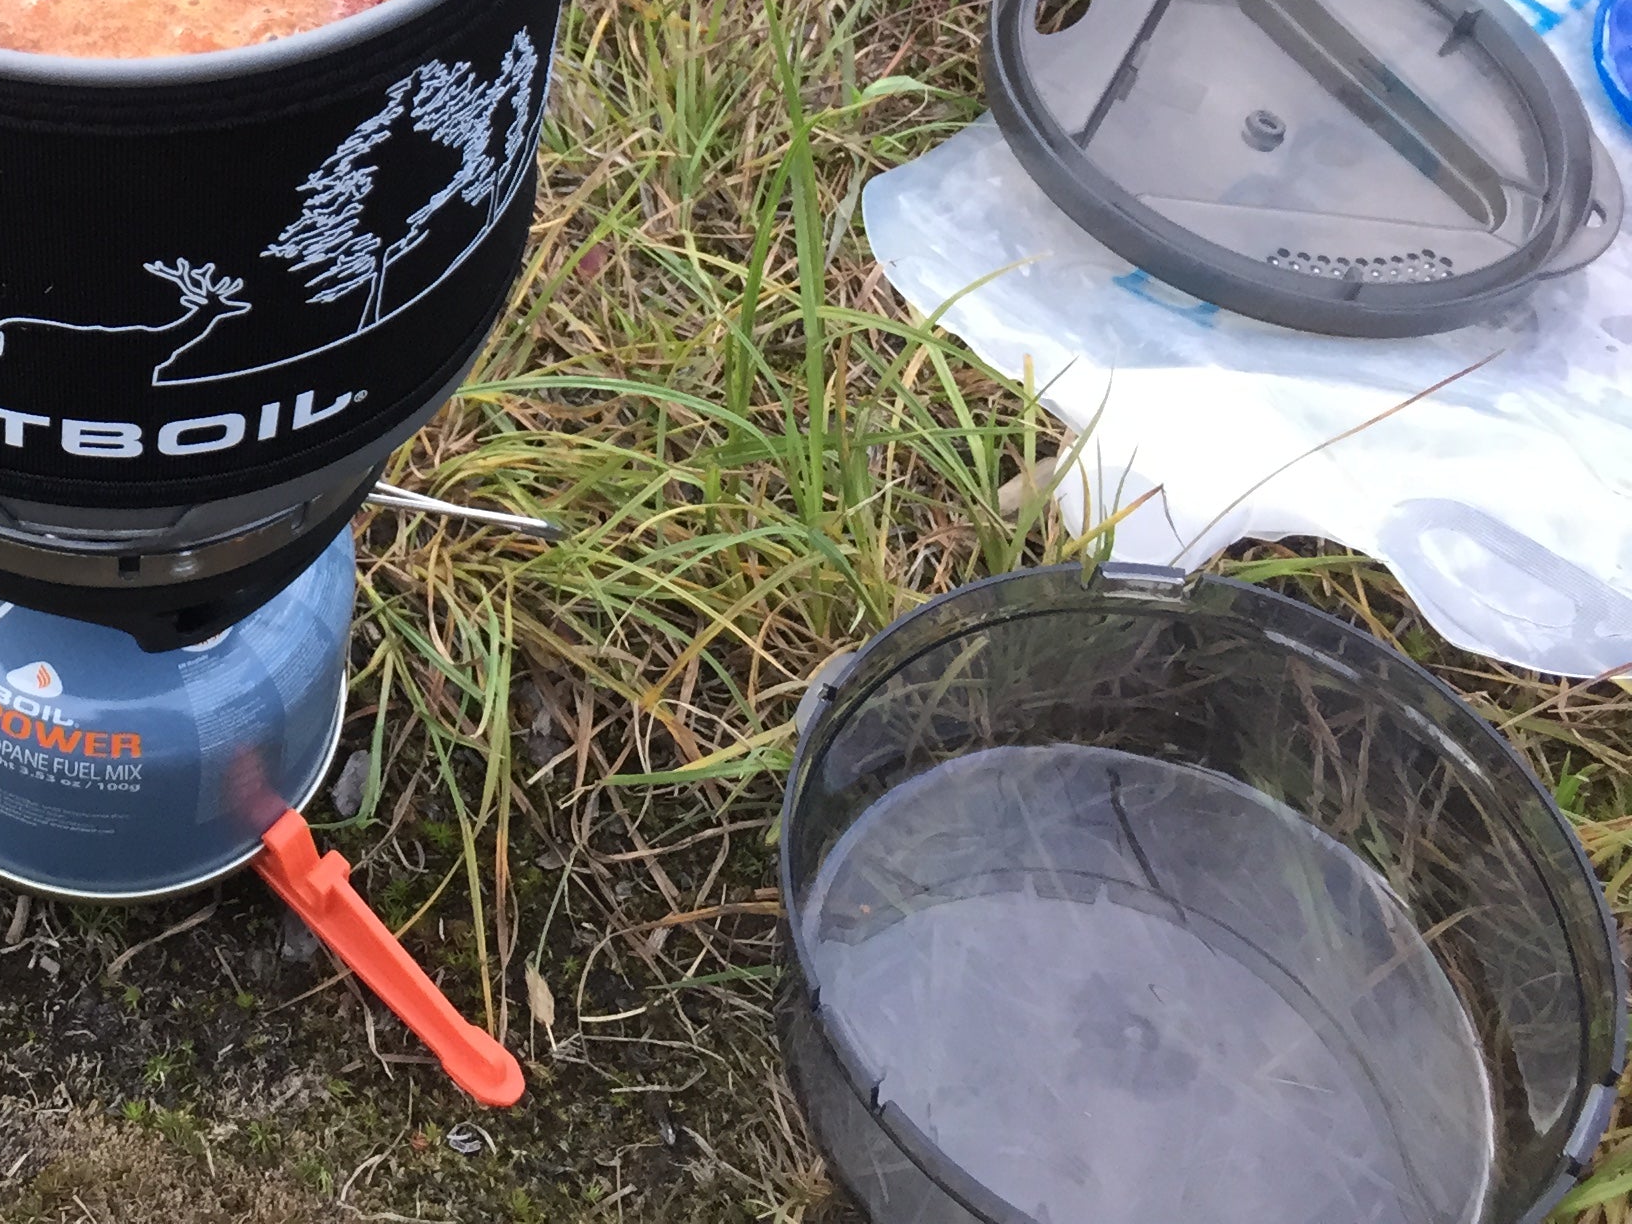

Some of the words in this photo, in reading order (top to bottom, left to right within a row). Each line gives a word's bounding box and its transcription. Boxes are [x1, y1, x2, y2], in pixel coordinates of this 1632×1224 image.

[18, 766, 56, 783] 3.53
[60, 780, 81, 789] oz
[97, 782, 141, 793] 100g
[53, 757, 99, 781] FUEL
[105, 764, 143, 781] MIX
